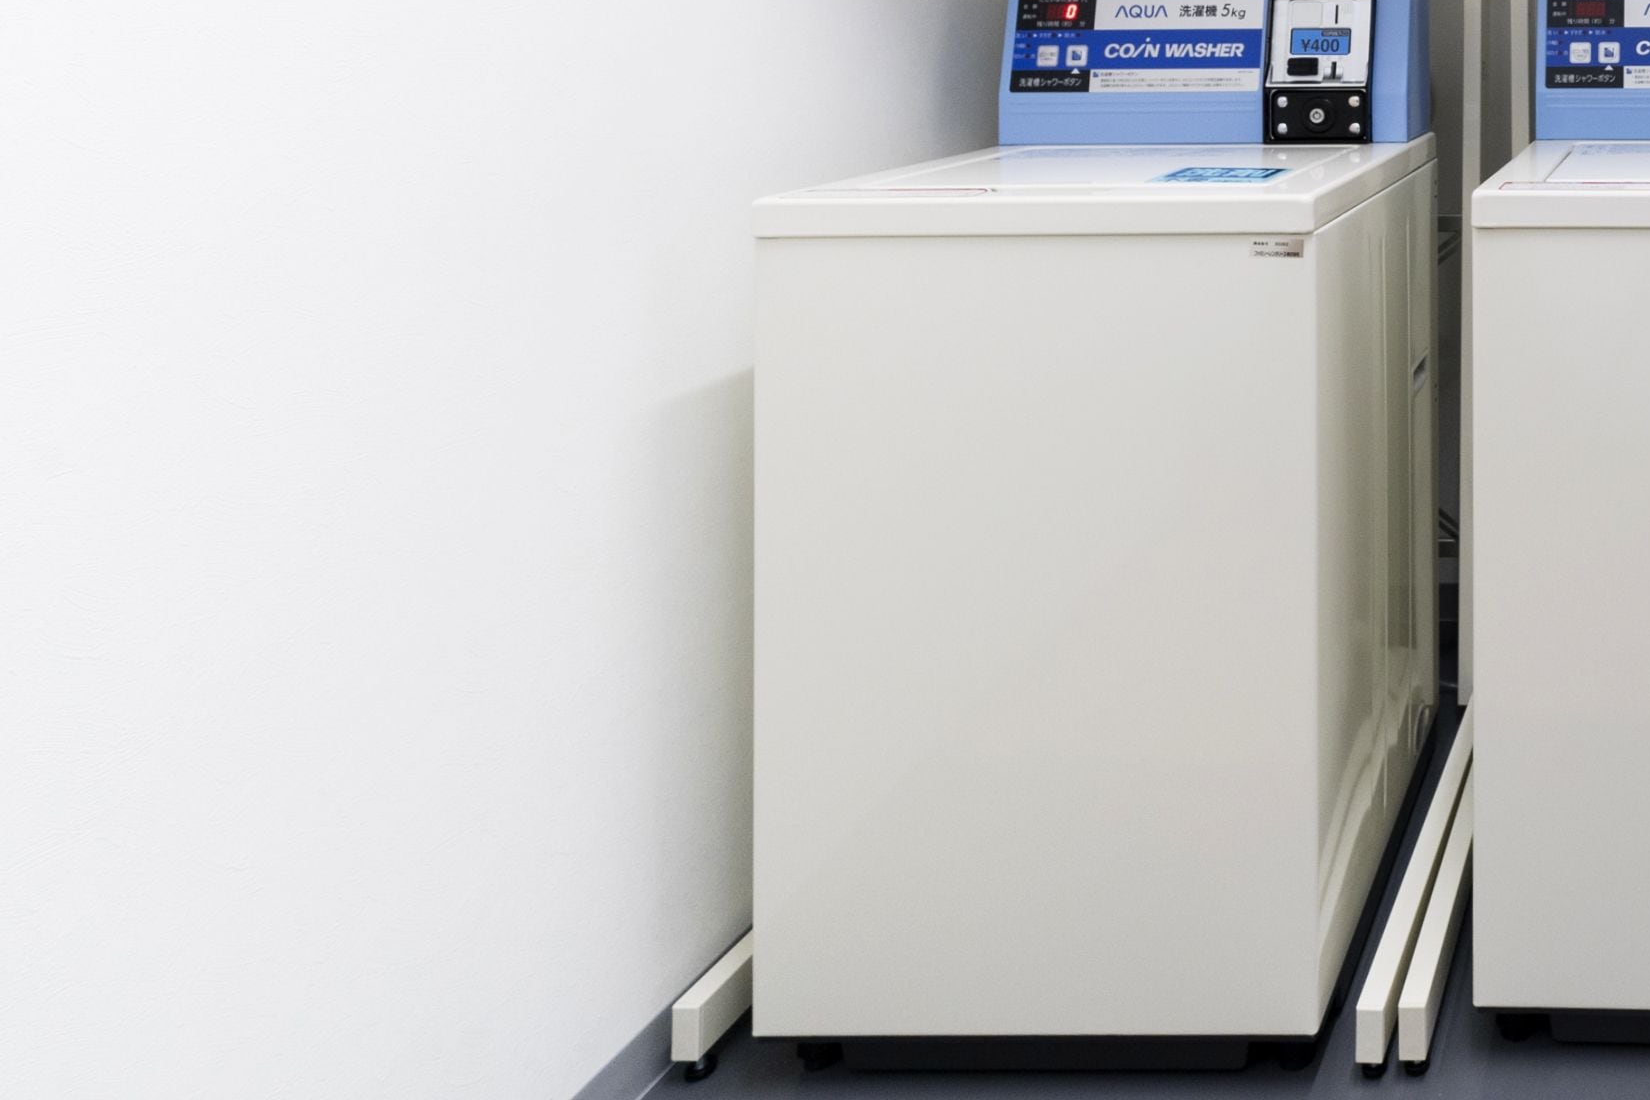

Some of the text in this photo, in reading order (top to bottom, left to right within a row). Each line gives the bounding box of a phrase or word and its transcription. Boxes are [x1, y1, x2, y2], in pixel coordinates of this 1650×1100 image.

[1065, 4, 1078, 19] 0
[1115, 4, 1168, 19] AQUA
[1179, 3, 1246, 20] 洗濯機 5kg
[1165, 43, 1245, 58] WASHER
[1301, 39, 1340, 52] ¥400
[1018, 77, 1082, 87] 洗濯槽シャワーボタン
[1554, 74, 1616, 83] 洗濯槽シャワーボタン
